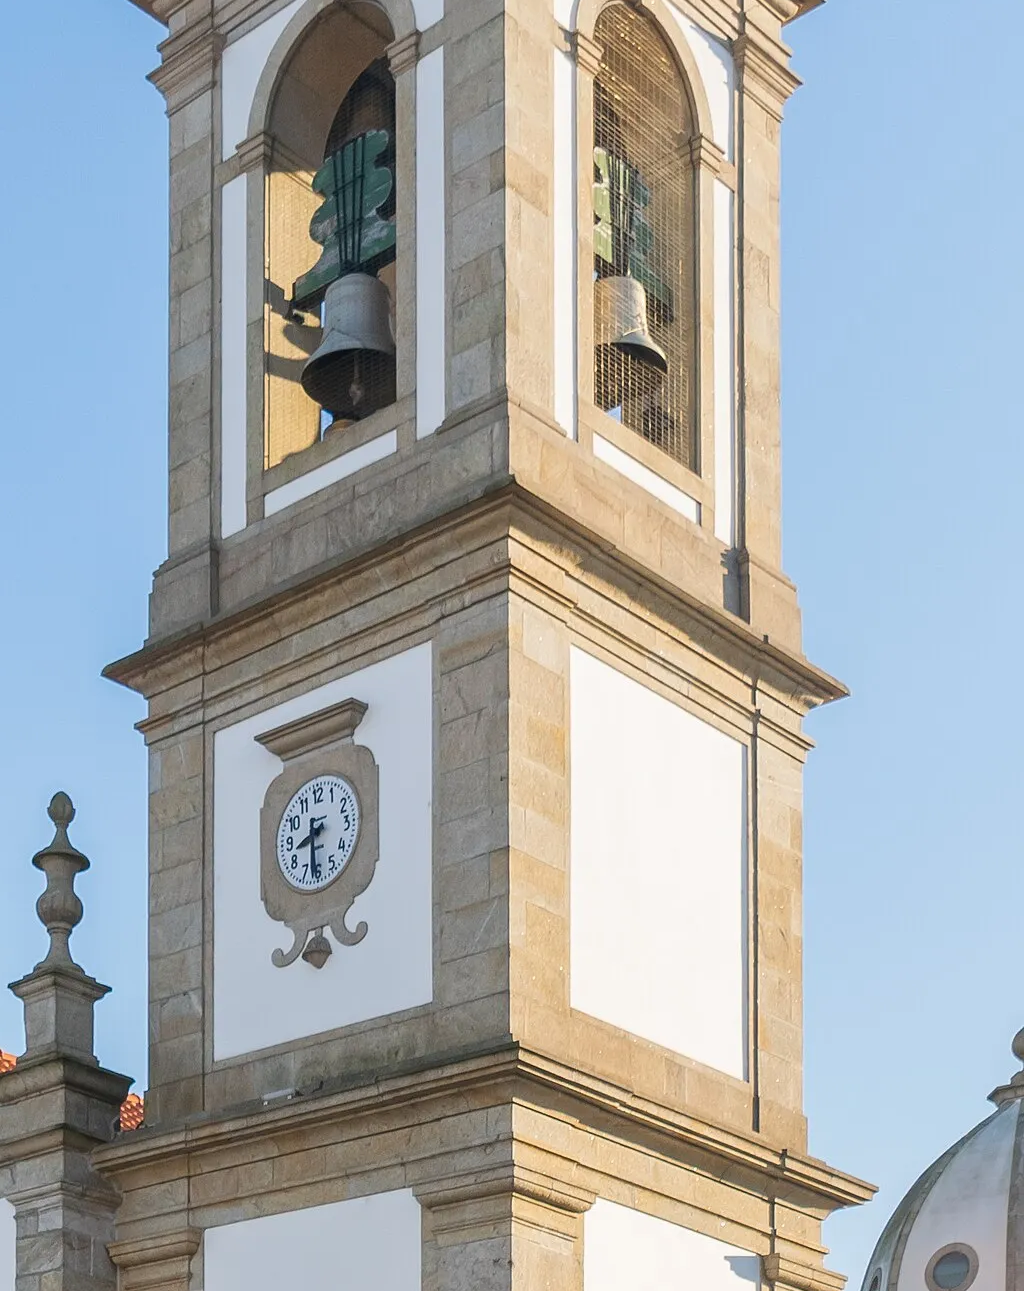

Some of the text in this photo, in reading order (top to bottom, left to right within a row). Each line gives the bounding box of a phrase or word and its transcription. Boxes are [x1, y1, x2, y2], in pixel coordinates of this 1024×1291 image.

[313, 787, 323, 804] 12
[330, 788, 333, 803] 1
[300, 798, 308, 813] 11
[340, 798, 347, 813] 2
[289, 815, 300, 832] 10
[344, 815, 350, 831] 3
[286, 837, 293, 851] 9
[338, 838, 345, 852] 4
[291, 855, 298, 869] 8
[329, 855, 335, 870] 5
[302, 865, 308, 880] 7
